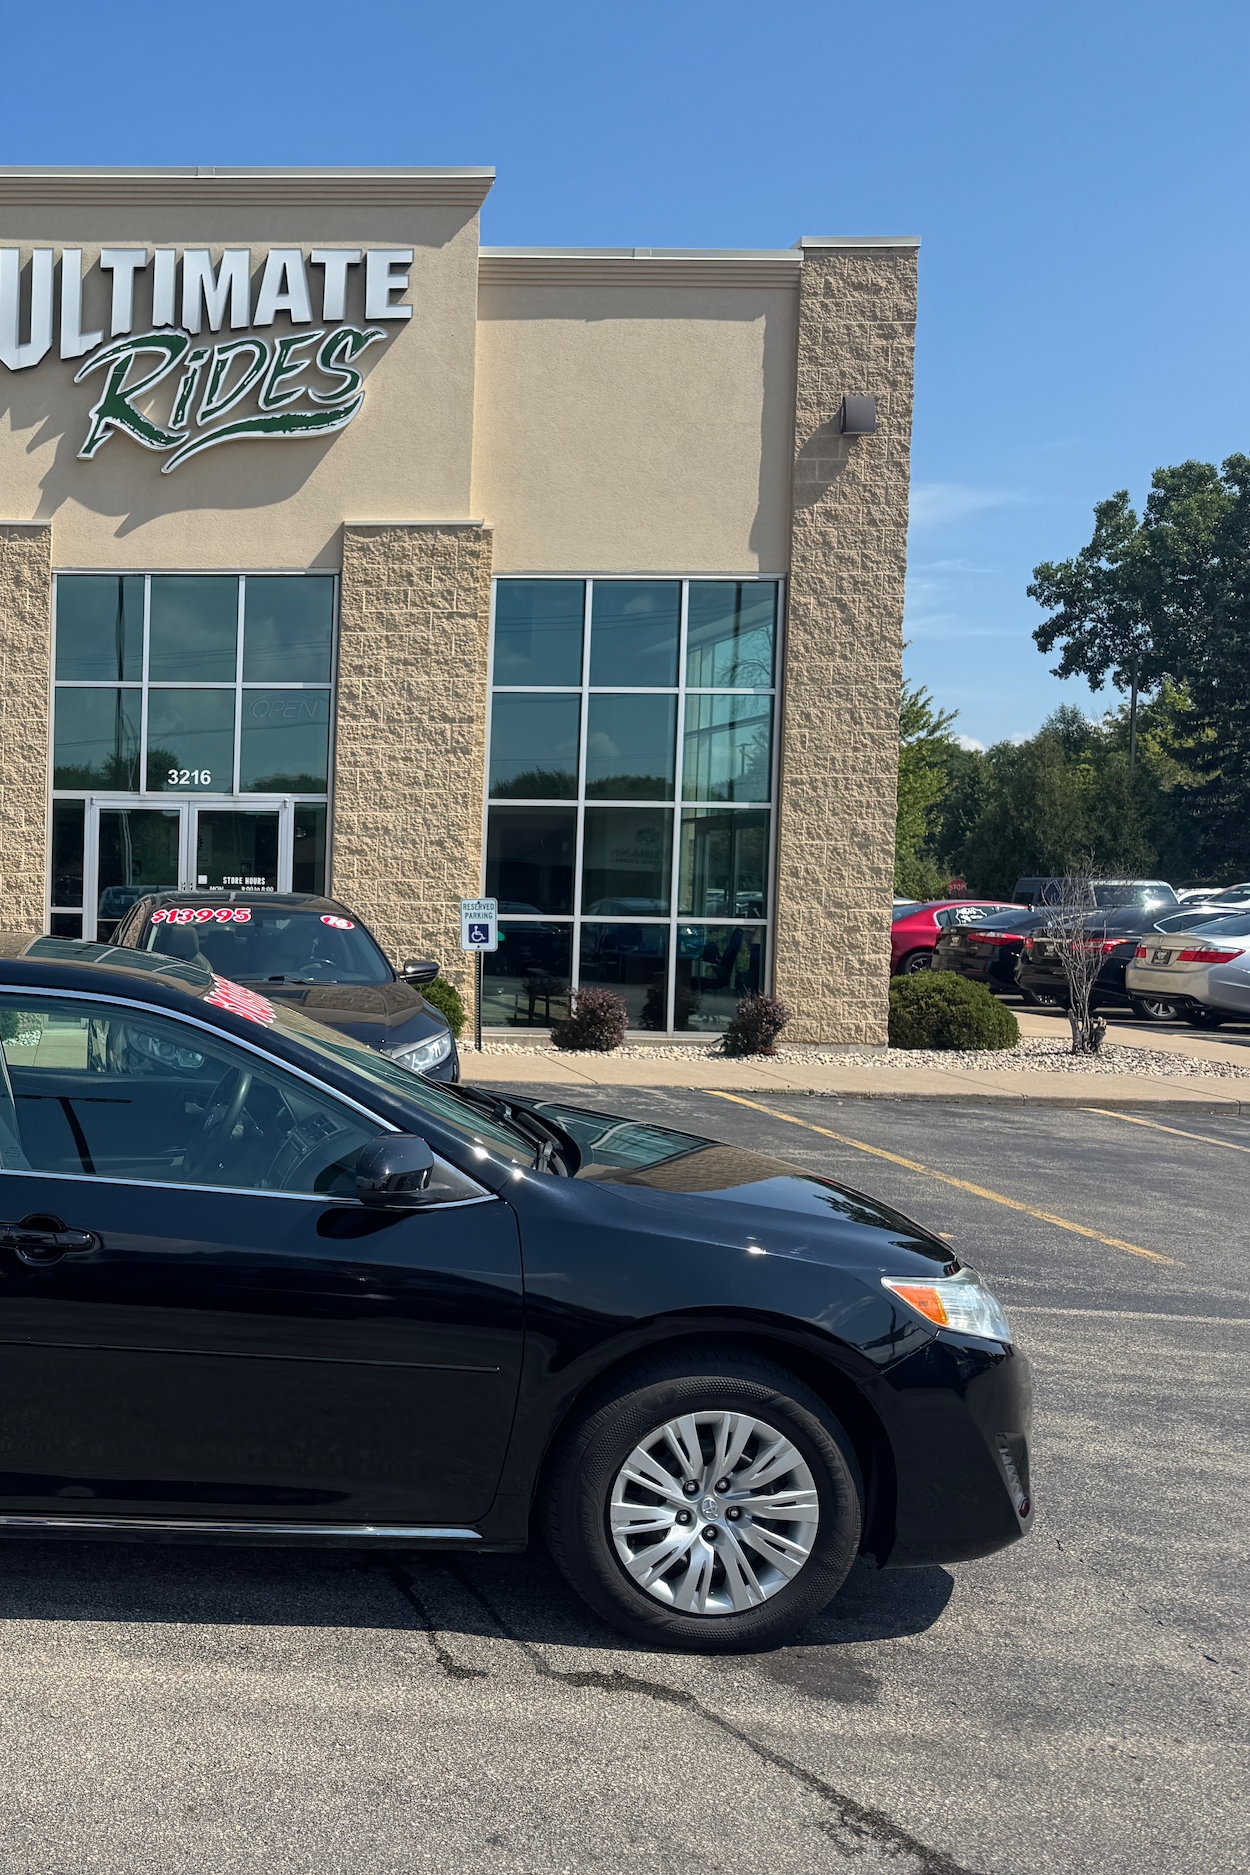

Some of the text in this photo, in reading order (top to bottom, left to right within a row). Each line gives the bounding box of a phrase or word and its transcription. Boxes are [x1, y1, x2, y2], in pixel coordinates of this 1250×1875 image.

[252, 700, 318, 718] OPEN
[167, 769, 211, 785] 3216
[222, 876, 266, 885] STORE HOURS
[463, 903, 495, 911] RESERVED
[151, 908, 251, 924] $13995
